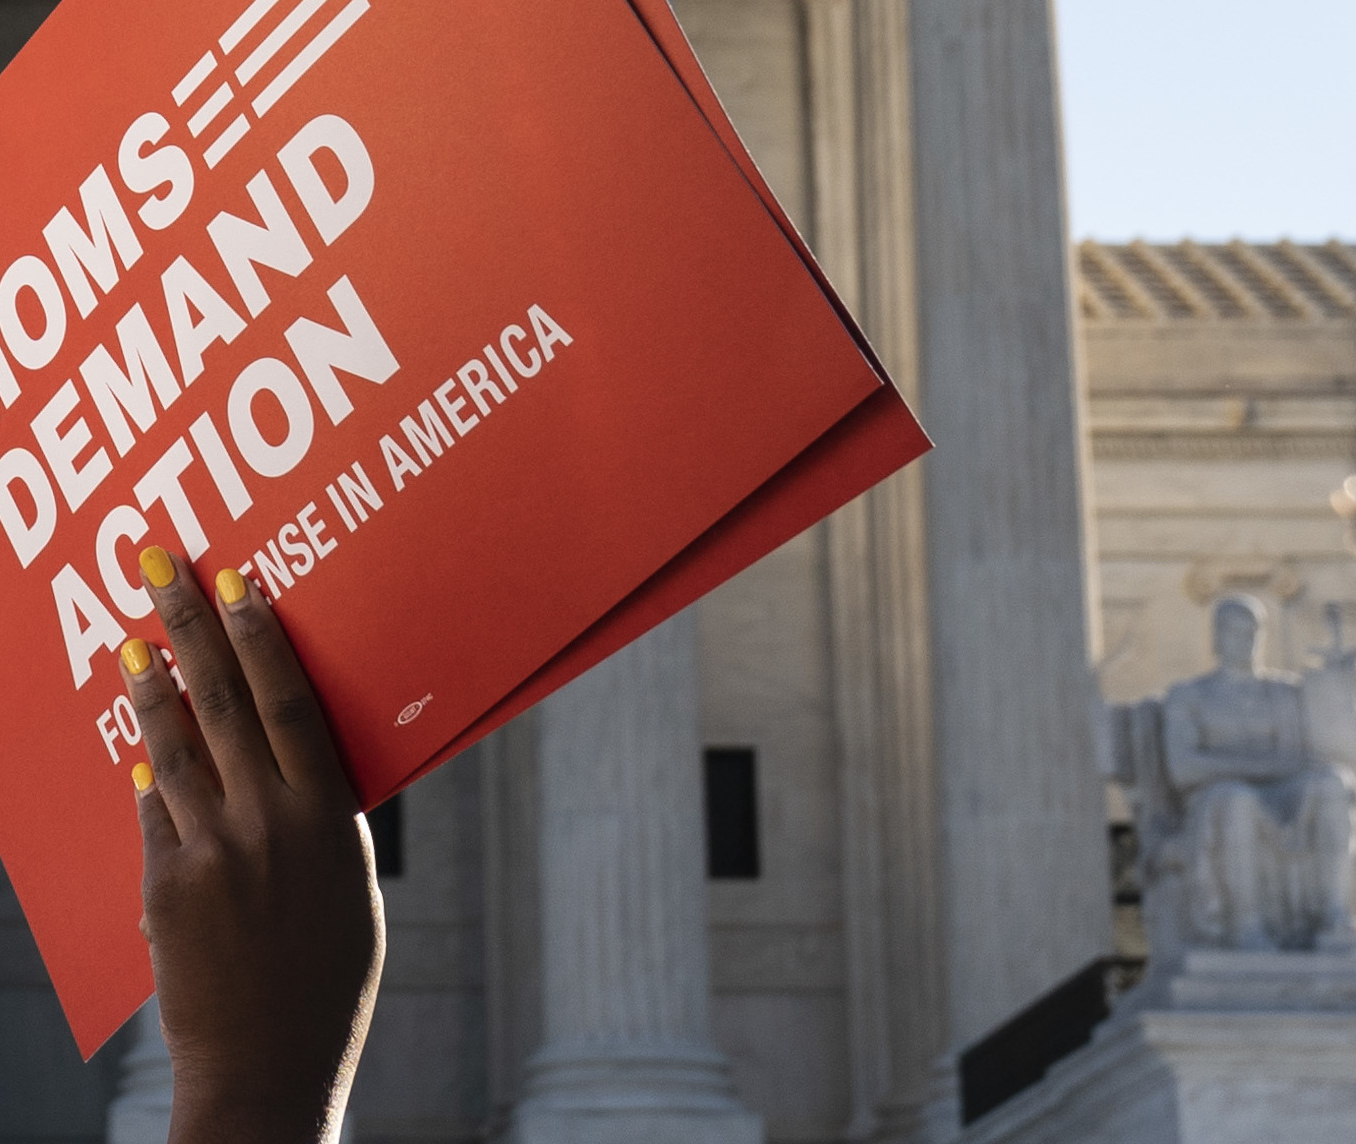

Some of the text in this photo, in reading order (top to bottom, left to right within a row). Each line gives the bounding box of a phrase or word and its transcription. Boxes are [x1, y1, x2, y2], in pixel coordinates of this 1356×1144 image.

[50, 274, 402, 690] ACTION
[95, 694, 142, 765] FO
[325, 460, 385, 534] IN
[378, 302, 575, 493] AMERICA
